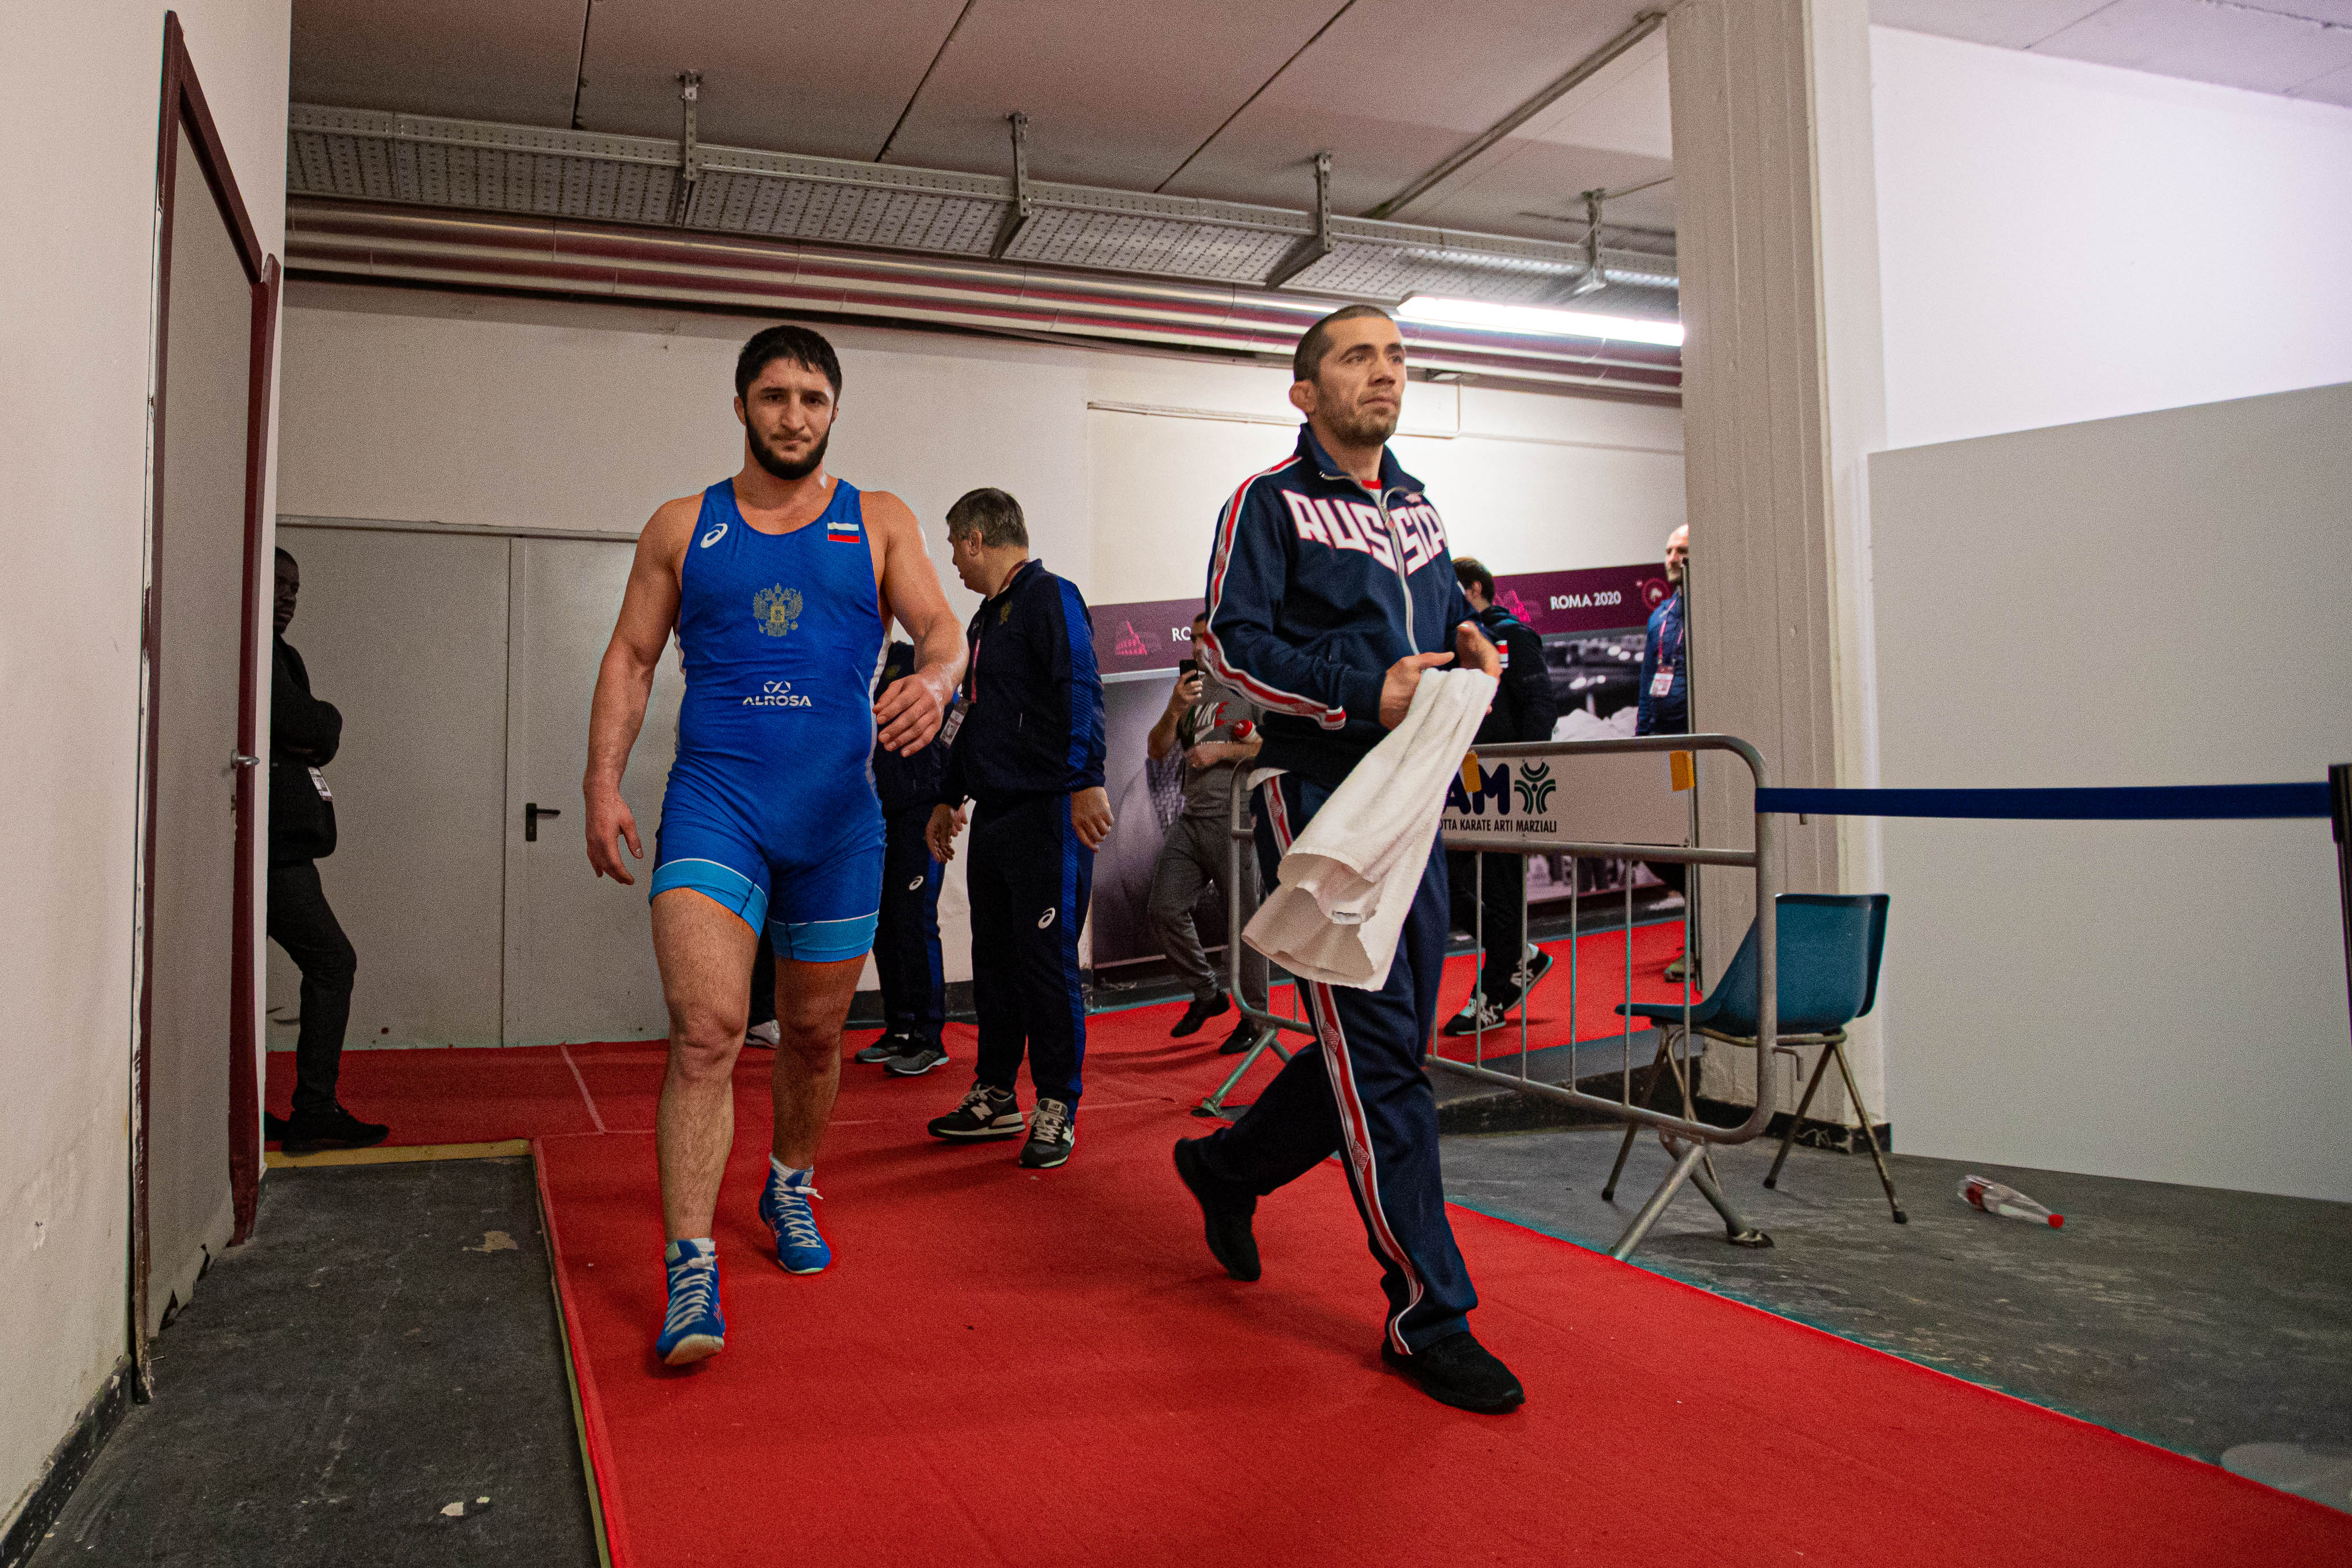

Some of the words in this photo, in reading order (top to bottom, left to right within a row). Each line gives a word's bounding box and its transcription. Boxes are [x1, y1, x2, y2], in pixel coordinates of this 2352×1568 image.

[1281, 489, 1449, 576] RUSSIA
[1551, 594, 1592, 610] ROMA
[1594, 591, 1621, 606] 2020
[1172, 627, 1191, 642] RO
[742, 695, 812, 706] ALROSA
[1460, 819, 1491, 832] KARATE
[1494, 820, 1513, 832] ARTI
[1516, 821, 1557, 833] MARZIALI
